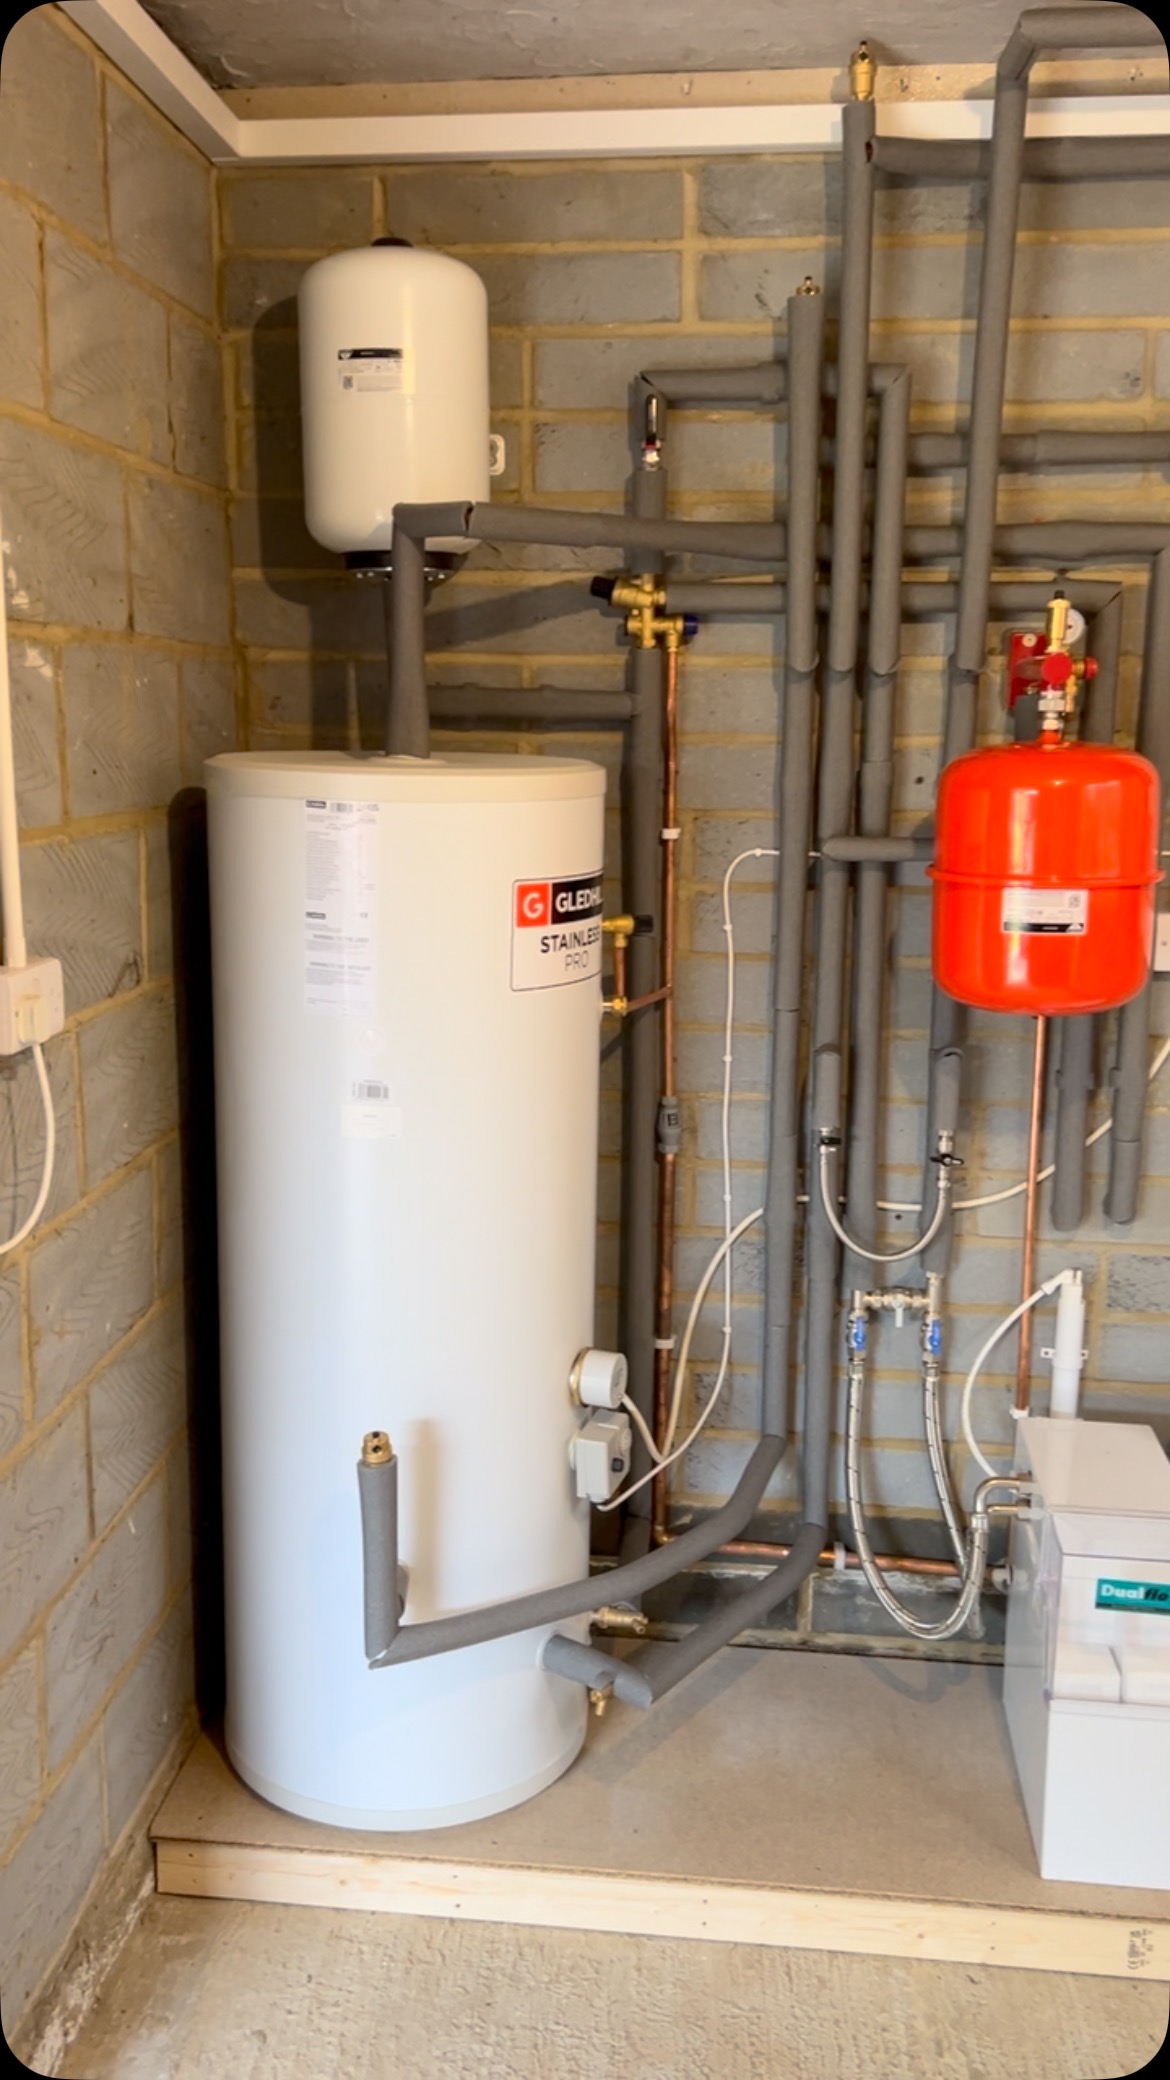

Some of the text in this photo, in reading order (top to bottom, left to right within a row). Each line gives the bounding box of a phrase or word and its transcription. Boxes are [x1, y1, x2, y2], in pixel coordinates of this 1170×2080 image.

[523, 891, 544, 919] G
[565, 950, 588, 971] PRO
[1101, 1583, 1168, 1602] Dualflo
